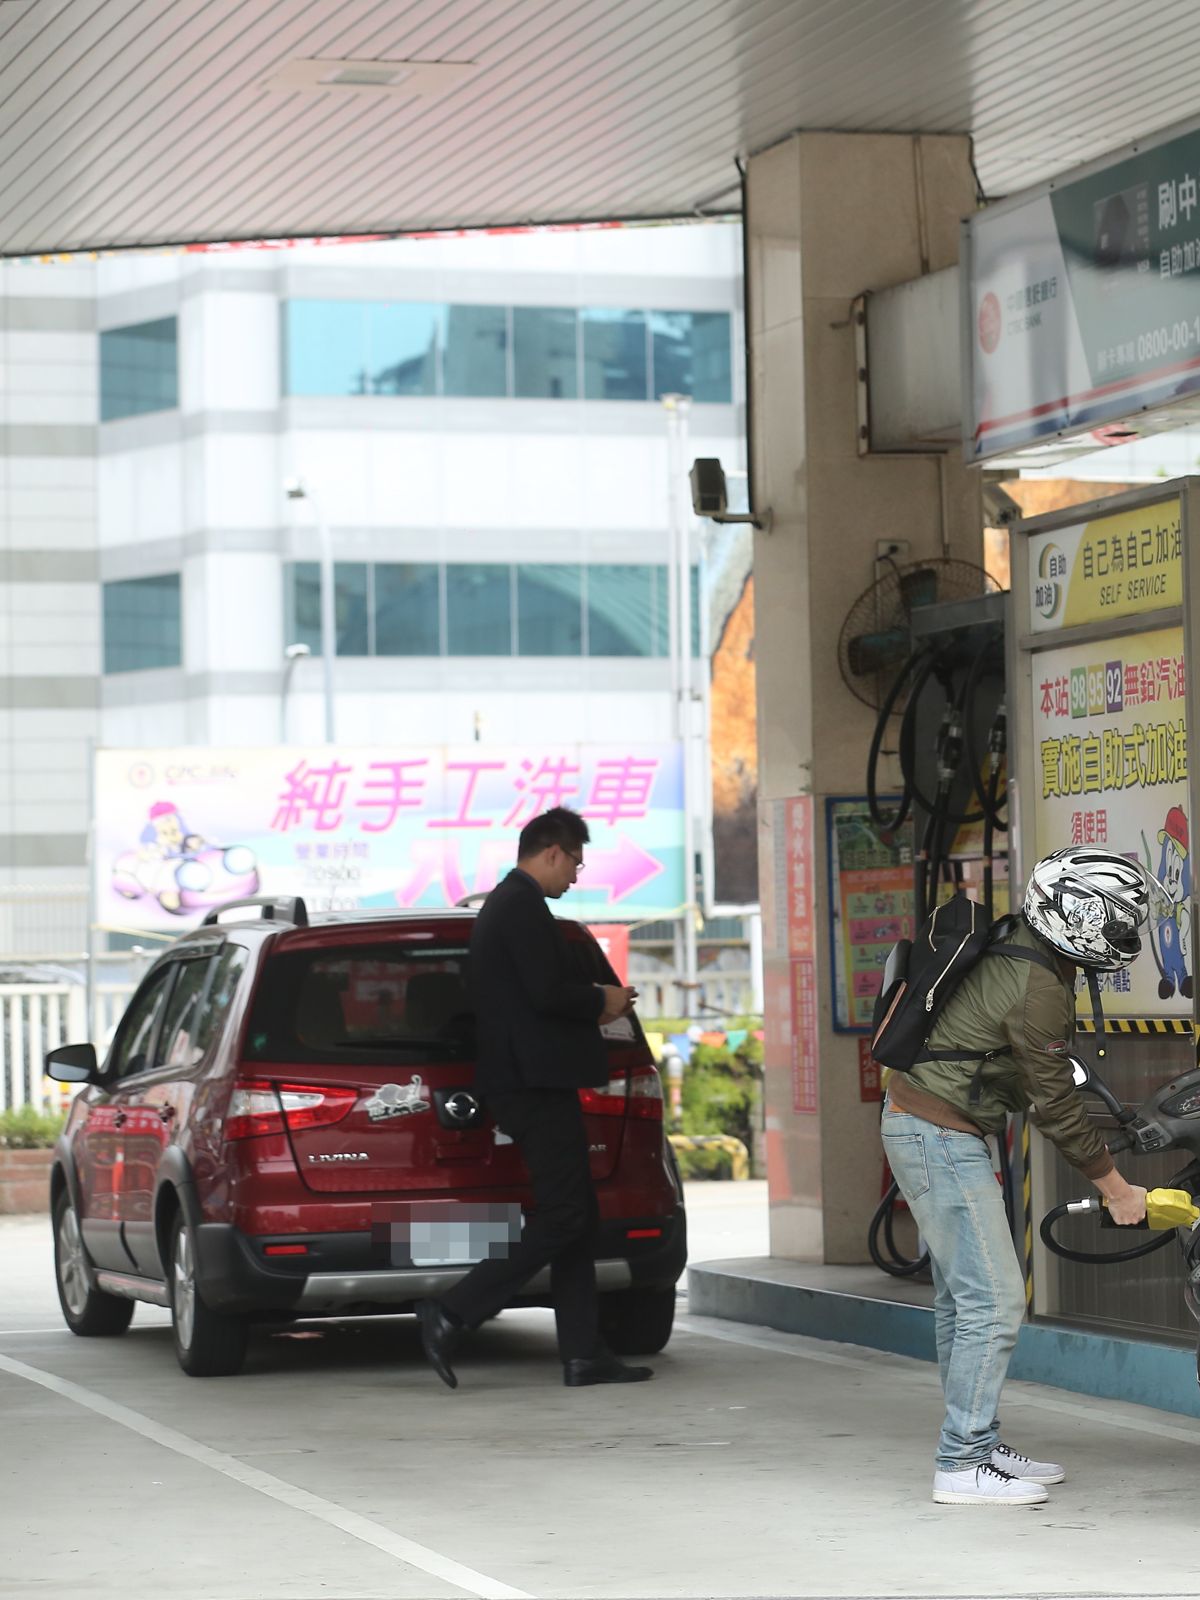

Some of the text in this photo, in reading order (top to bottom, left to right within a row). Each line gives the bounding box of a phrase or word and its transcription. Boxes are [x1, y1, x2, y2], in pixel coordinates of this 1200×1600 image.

[1082, 520, 1182, 581] 自己為自己加油
[1100, 574, 1167, 606] SELF SERVICE
[1040, 718, 1188, 800] 實施自助式加油
[268, 756, 660, 835] 純手工洗車
[1071, 809, 1108, 844] 須使用
